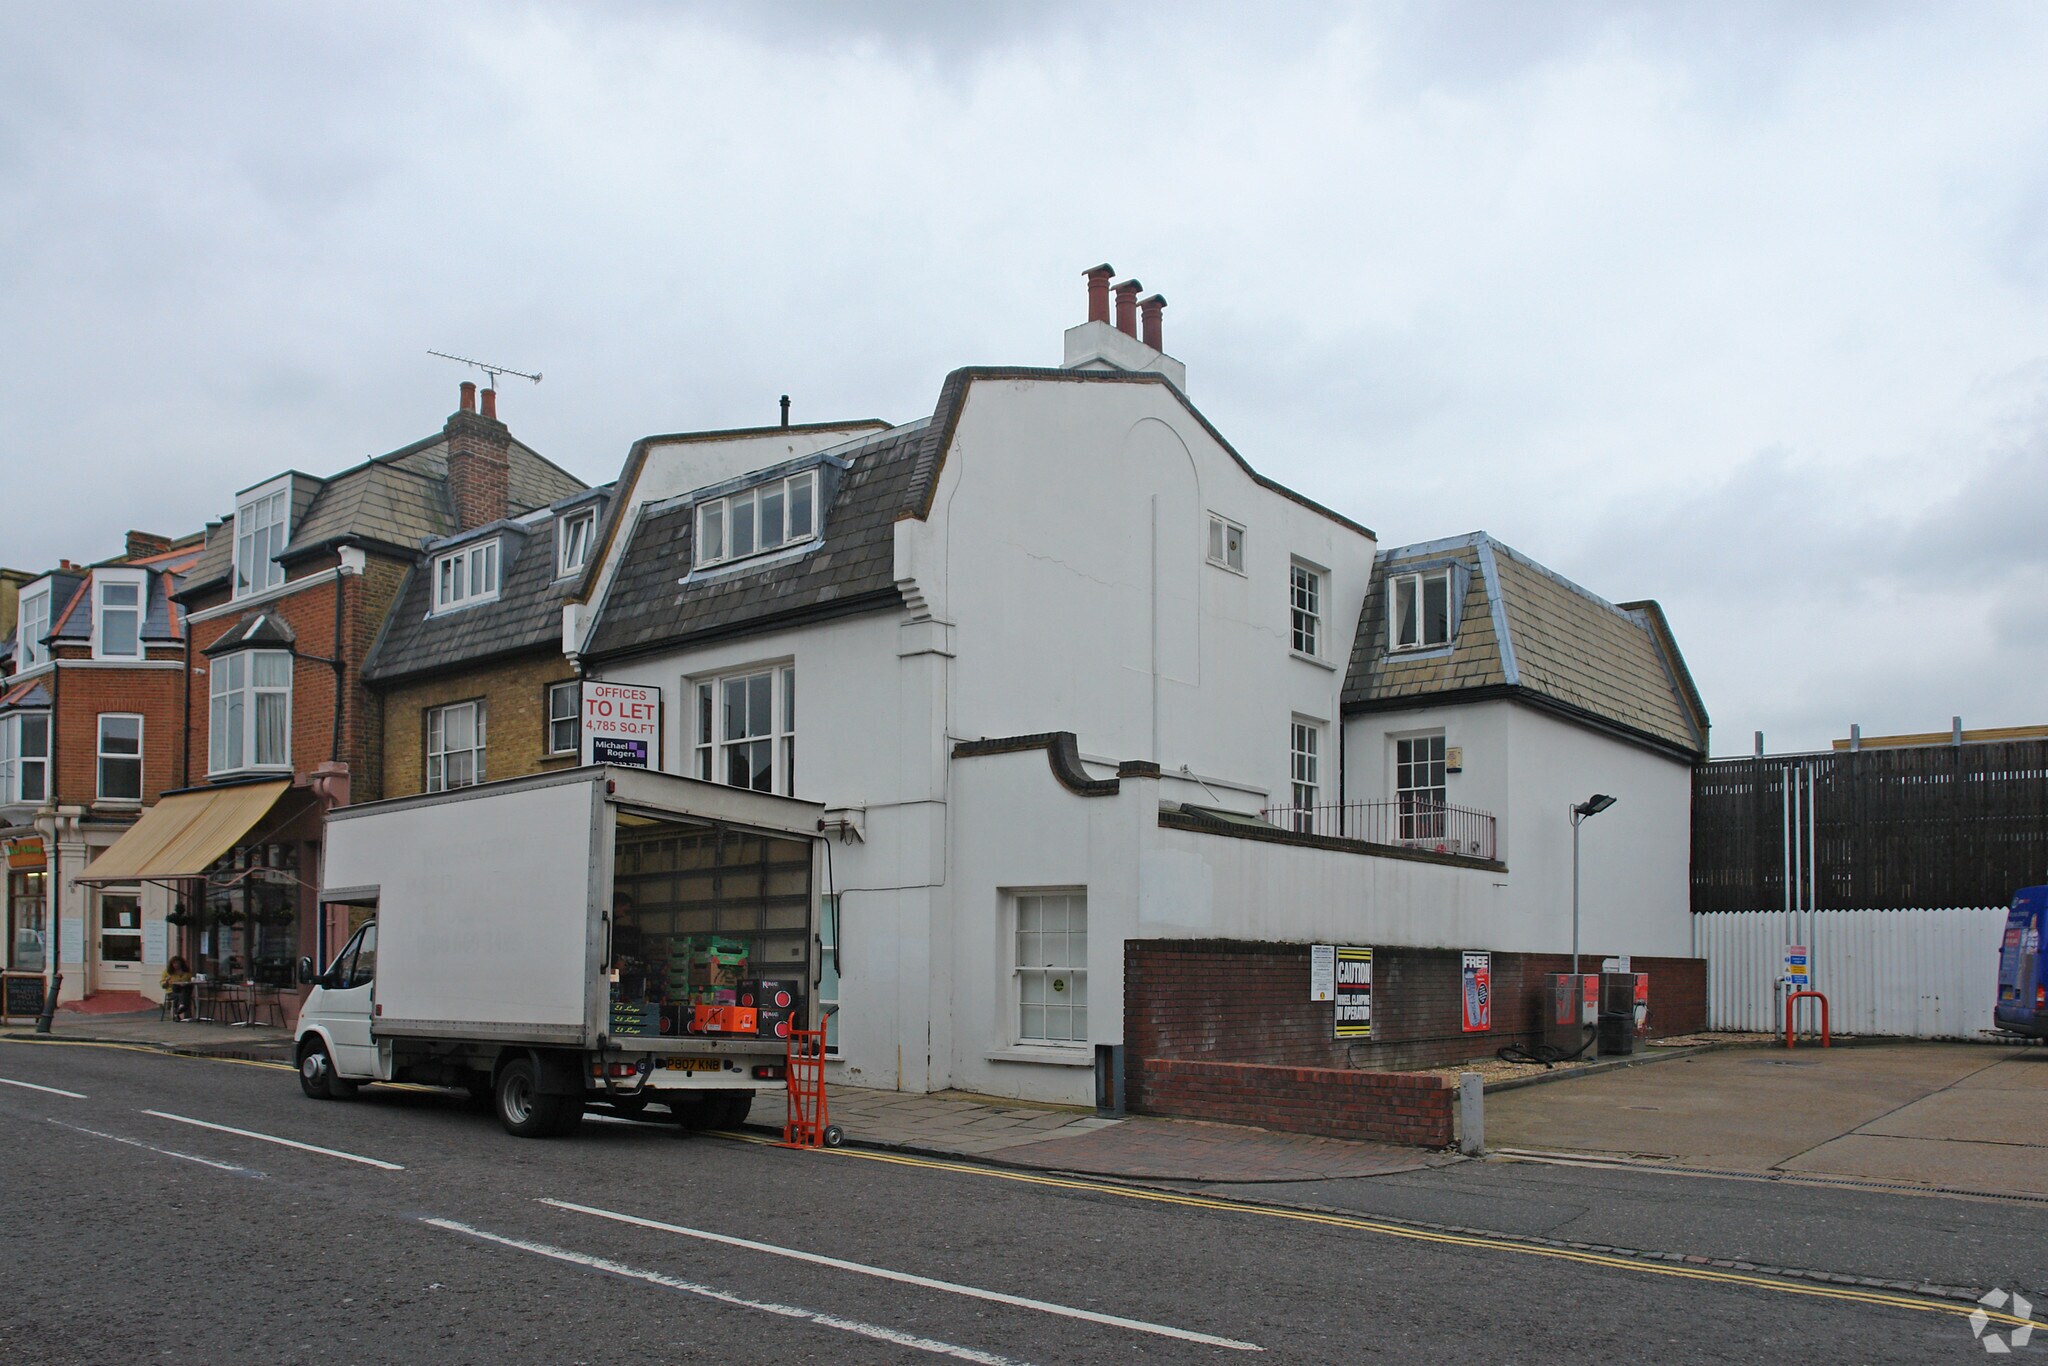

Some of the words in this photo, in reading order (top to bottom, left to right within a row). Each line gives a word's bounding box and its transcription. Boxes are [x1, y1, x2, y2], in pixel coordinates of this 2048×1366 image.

[595, 687, 647, 700] OFFICES
[586, 699, 612, 716] TO
[620, 702, 655, 720] LET
[586, 720, 616, 732] 4,785
[620, 722, 655, 734] SQ.FT
[595, 741, 628, 750] Michael
[607, 749, 636, 758] Rogers
[1464, 956, 1488, 968] FREE
[1338, 962, 1371, 983] CAUTION
[667, 1059, 695, 1069] P807
